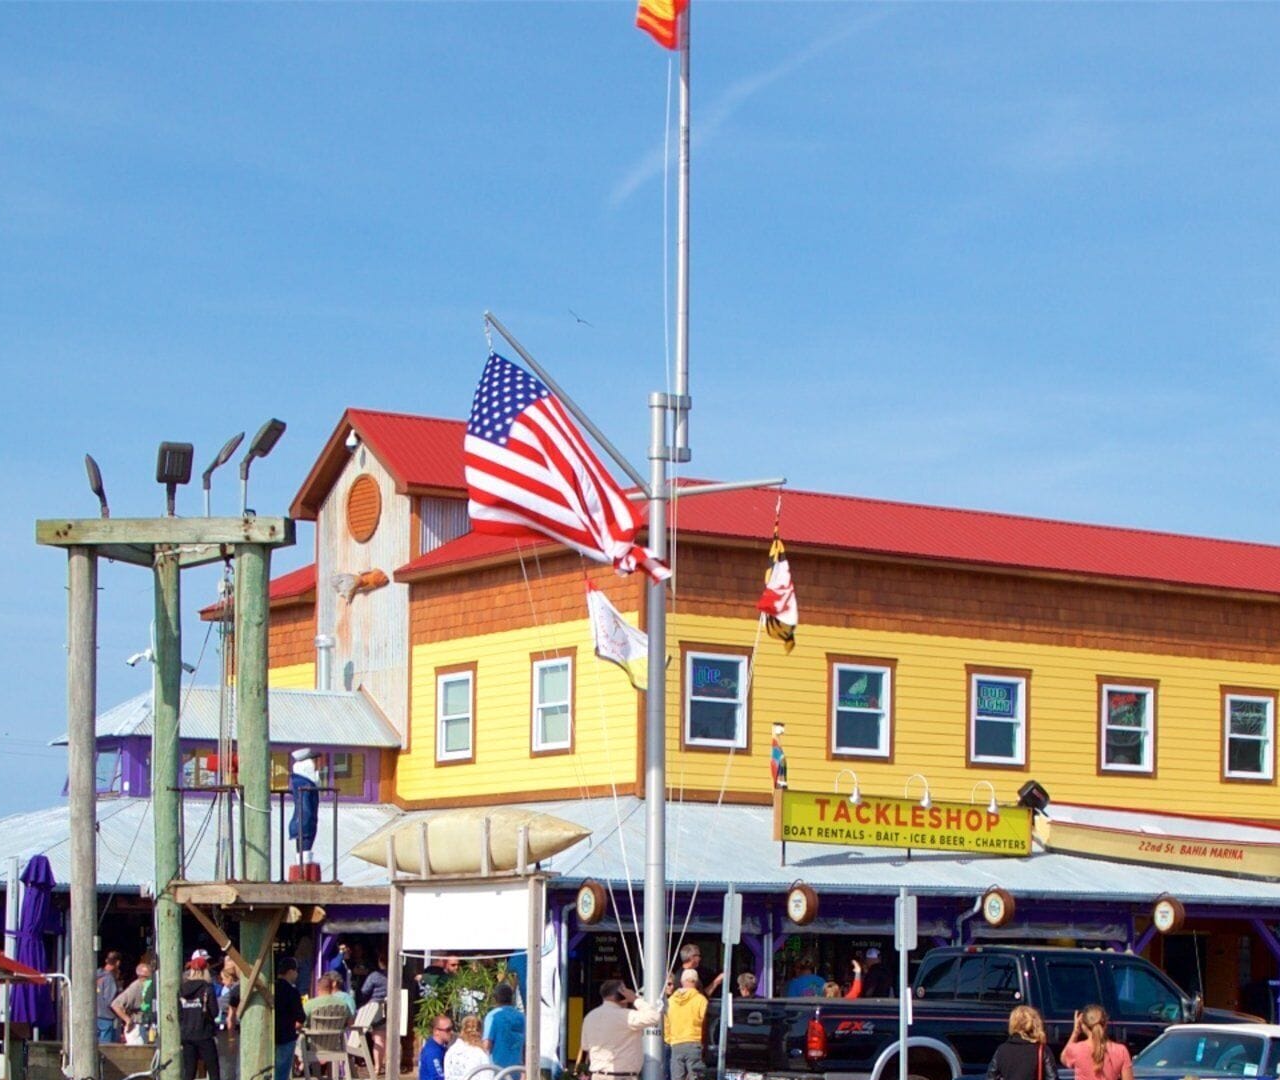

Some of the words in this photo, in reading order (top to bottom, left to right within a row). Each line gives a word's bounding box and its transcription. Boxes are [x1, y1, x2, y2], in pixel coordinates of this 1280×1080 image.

[980, 687, 1008, 700] BUD
[977, 697, 1011, 712] LIGHT
[815, 798, 1001, 832] TACKLESHOP
[783, 825, 813, 837] BOAT
[817, 827, 865, 840] RENTALS
[875, 831, 900, 842] BAIT
[910, 834, 926, 844] ICE
[930, 835, 936, 844] &
[940, 835, 965, 847] BEER
[975, 838, 1026, 850] CHARTERS
[1138, 840, 1161, 853] 22nd
[1179, 844, 1208, 857] BAHIA
[1209, 847, 1244, 861] MARINA
